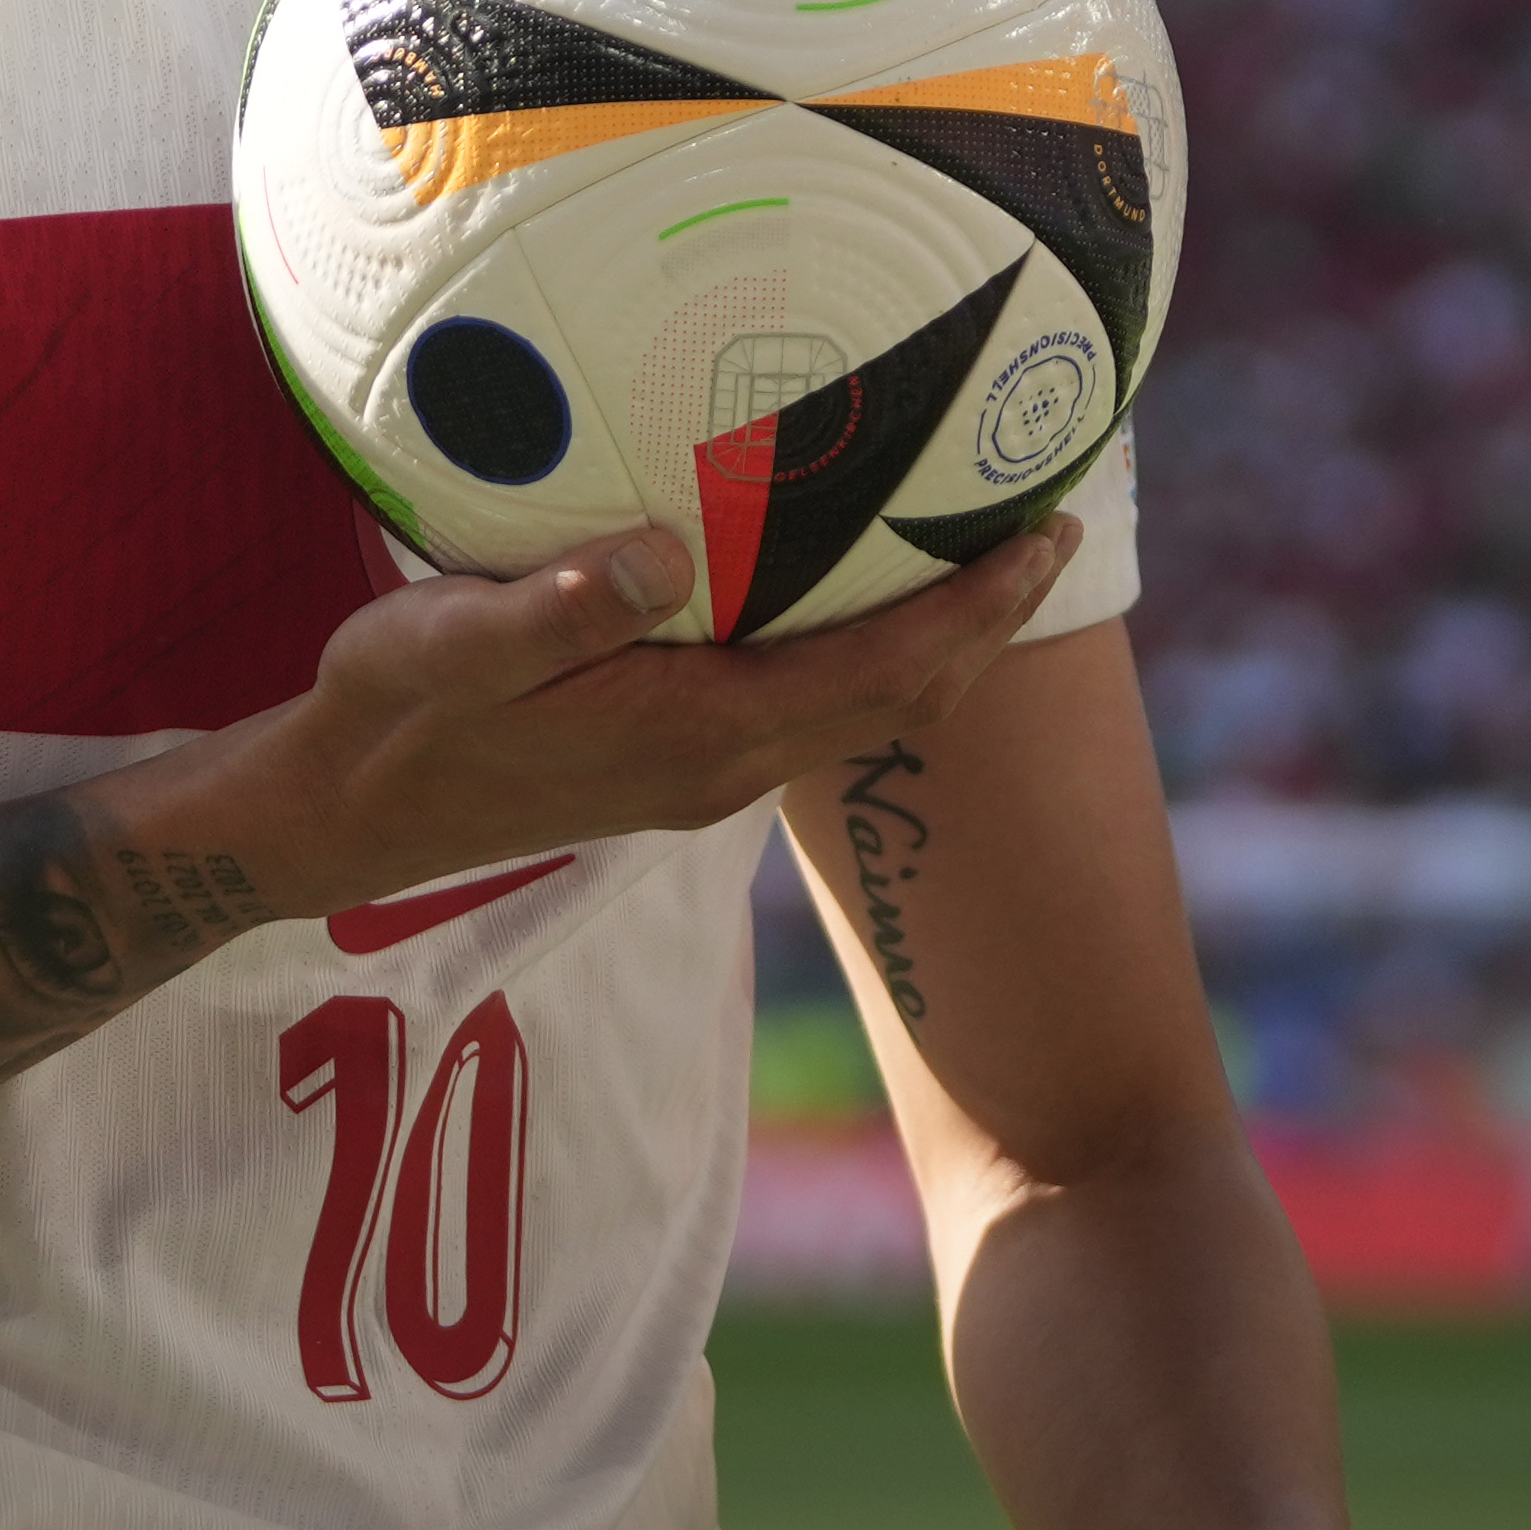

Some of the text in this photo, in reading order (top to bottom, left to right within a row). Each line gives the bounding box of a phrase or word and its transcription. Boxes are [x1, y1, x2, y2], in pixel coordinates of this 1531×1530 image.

[1093, 143, 1146, 223] DORTMUND
[985, 330, 1097, 403] PRECISIONSHELL
[278, 988, 529, 1403] 10
